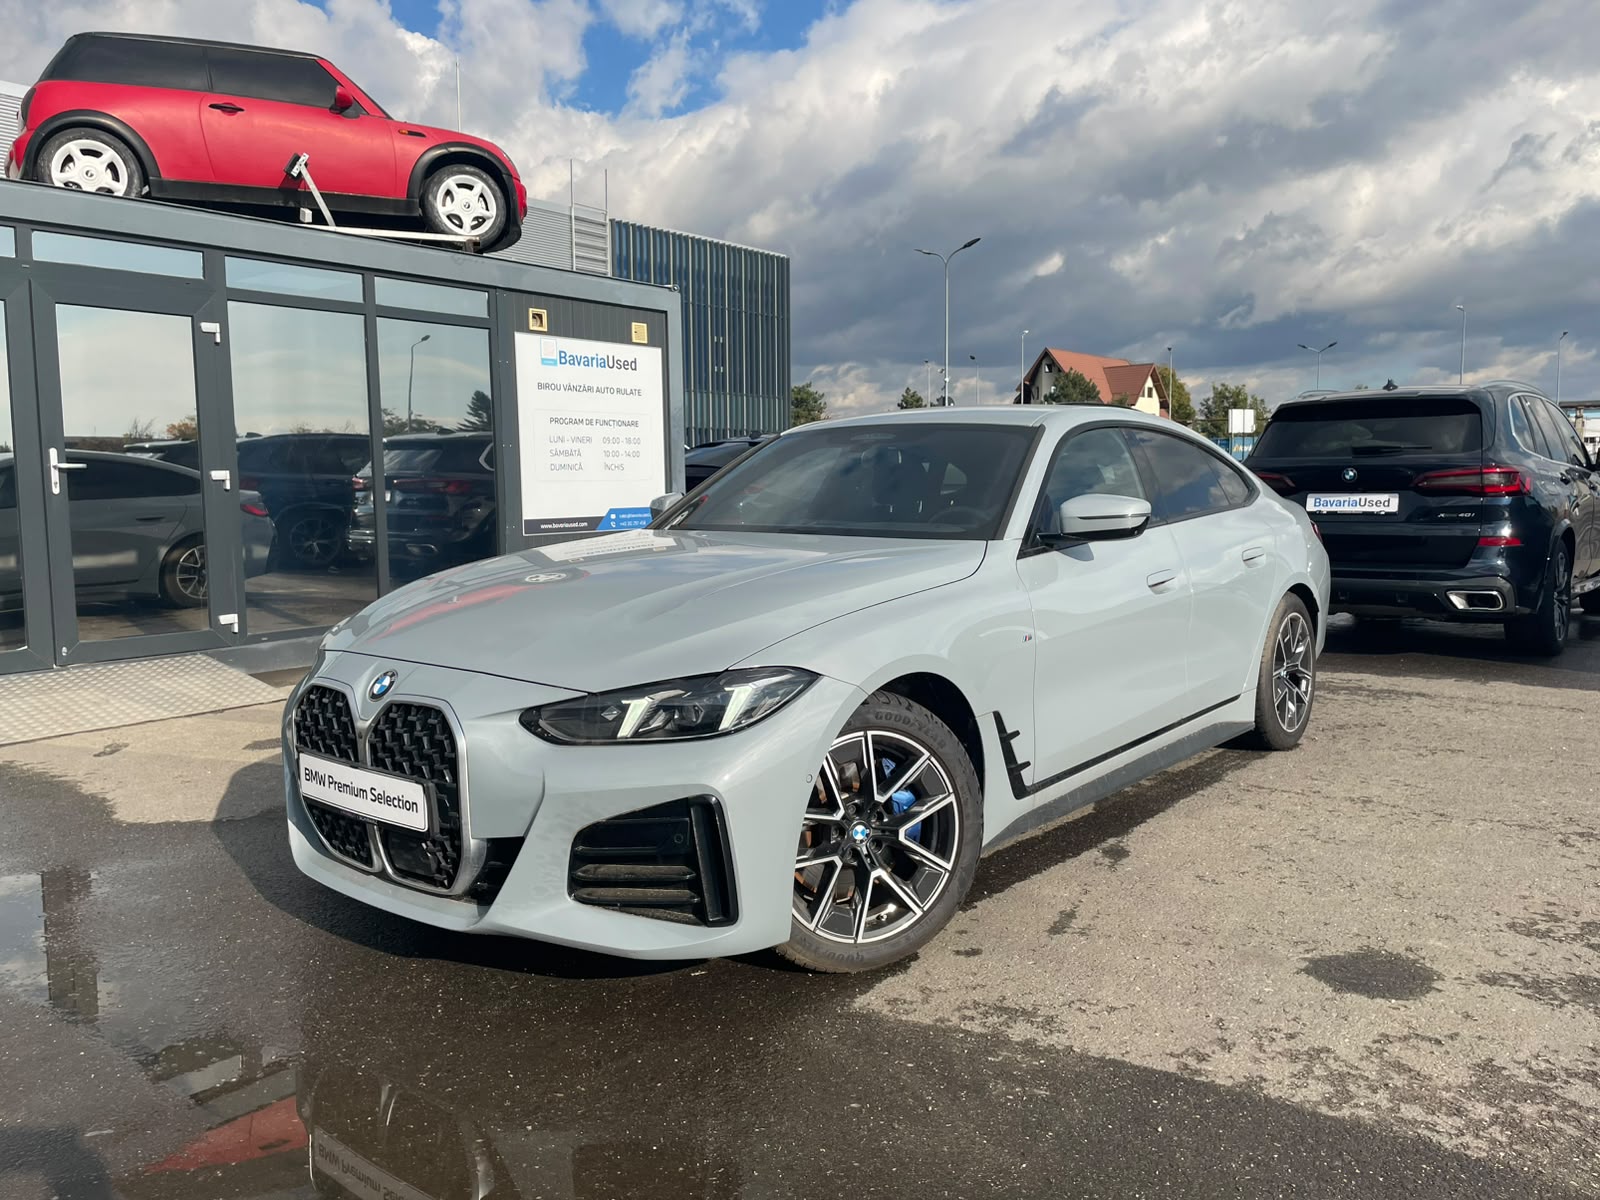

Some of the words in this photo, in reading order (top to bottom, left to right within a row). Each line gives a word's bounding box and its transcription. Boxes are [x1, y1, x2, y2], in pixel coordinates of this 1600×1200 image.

[558, 350, 638, 372] BavariaUsed
[537, 382, 561, 392] BIROU
[595, 386, 615, 395] AUTO
[616, 387, 642, 397] RULATE
[549, 416, 584, 426] PROGRAM
[585, 418, 594, 426] DE
[549, 435, 566, 444] LUNI
[570, 435, 593, 444] VINERI
[1313, 497, 1391, 508] BavariaUsed
[304, 767, 326, 788] BMW
[328, 775, 368, 800] Premium
[369, 786, 418, 813] Selection
